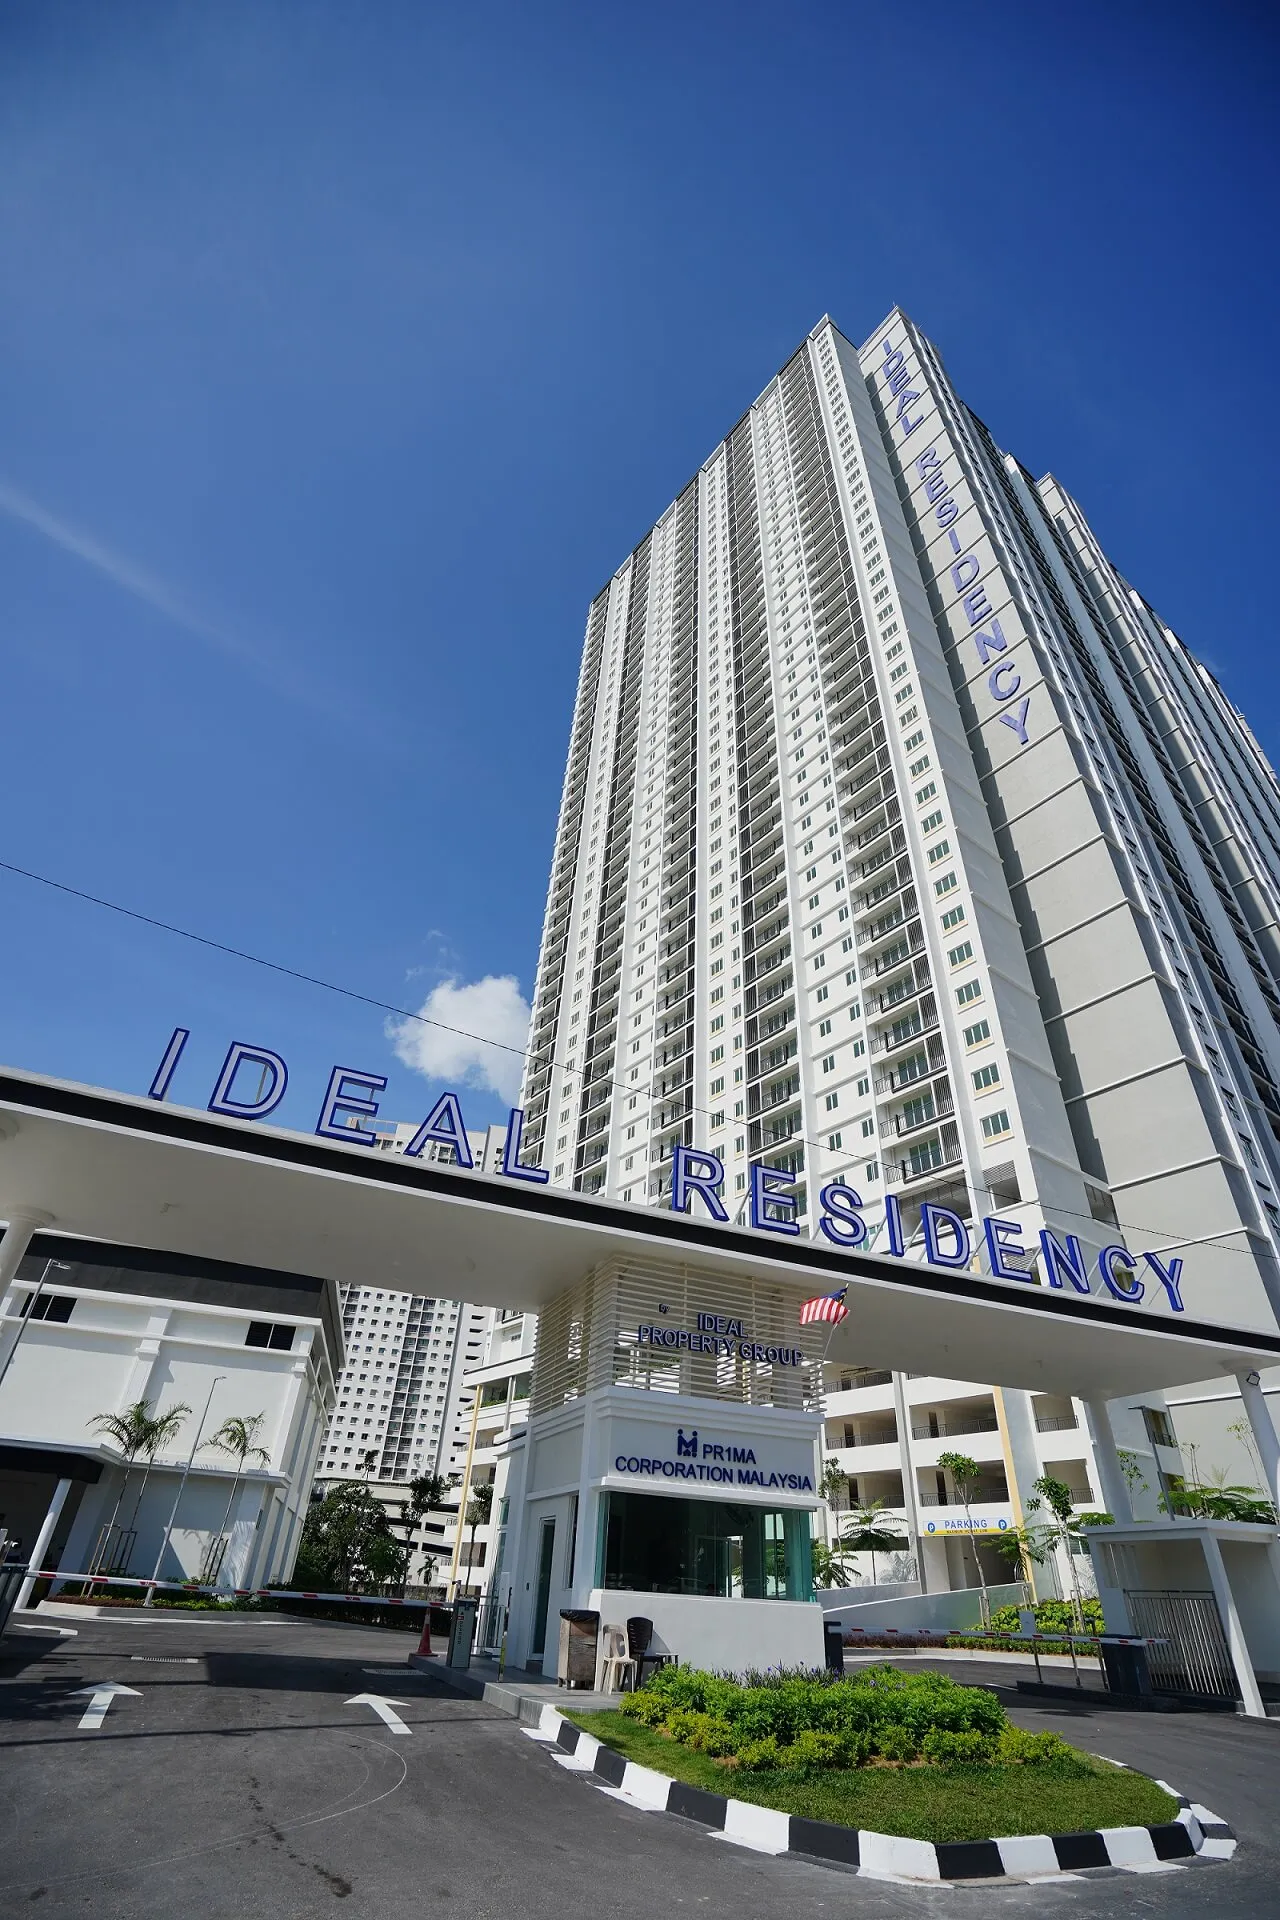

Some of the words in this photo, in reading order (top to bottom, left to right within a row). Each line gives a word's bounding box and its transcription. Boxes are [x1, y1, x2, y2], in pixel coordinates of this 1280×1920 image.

[883, 340, 924, 436] IDEAL
[916, 447, 1030, 745] RESIDENCY
[149, 1028, 550, 1183] IDEAL
[672, 1146, 1184, 1312] RESIDENCY
[697, 1312, 749, 1338] IDEAL
[638, 1325, 736, 1356] PROPERTY
[738, 1342, 804, 1366] GROUP
[702, 1444, 756, 1465] PR1MA
[615, 1456, 733, 1484] CORPORATION
[738, 1469, 812, 1491] MALAYSIA
[944, 1519, 988, 1529] PARKING
